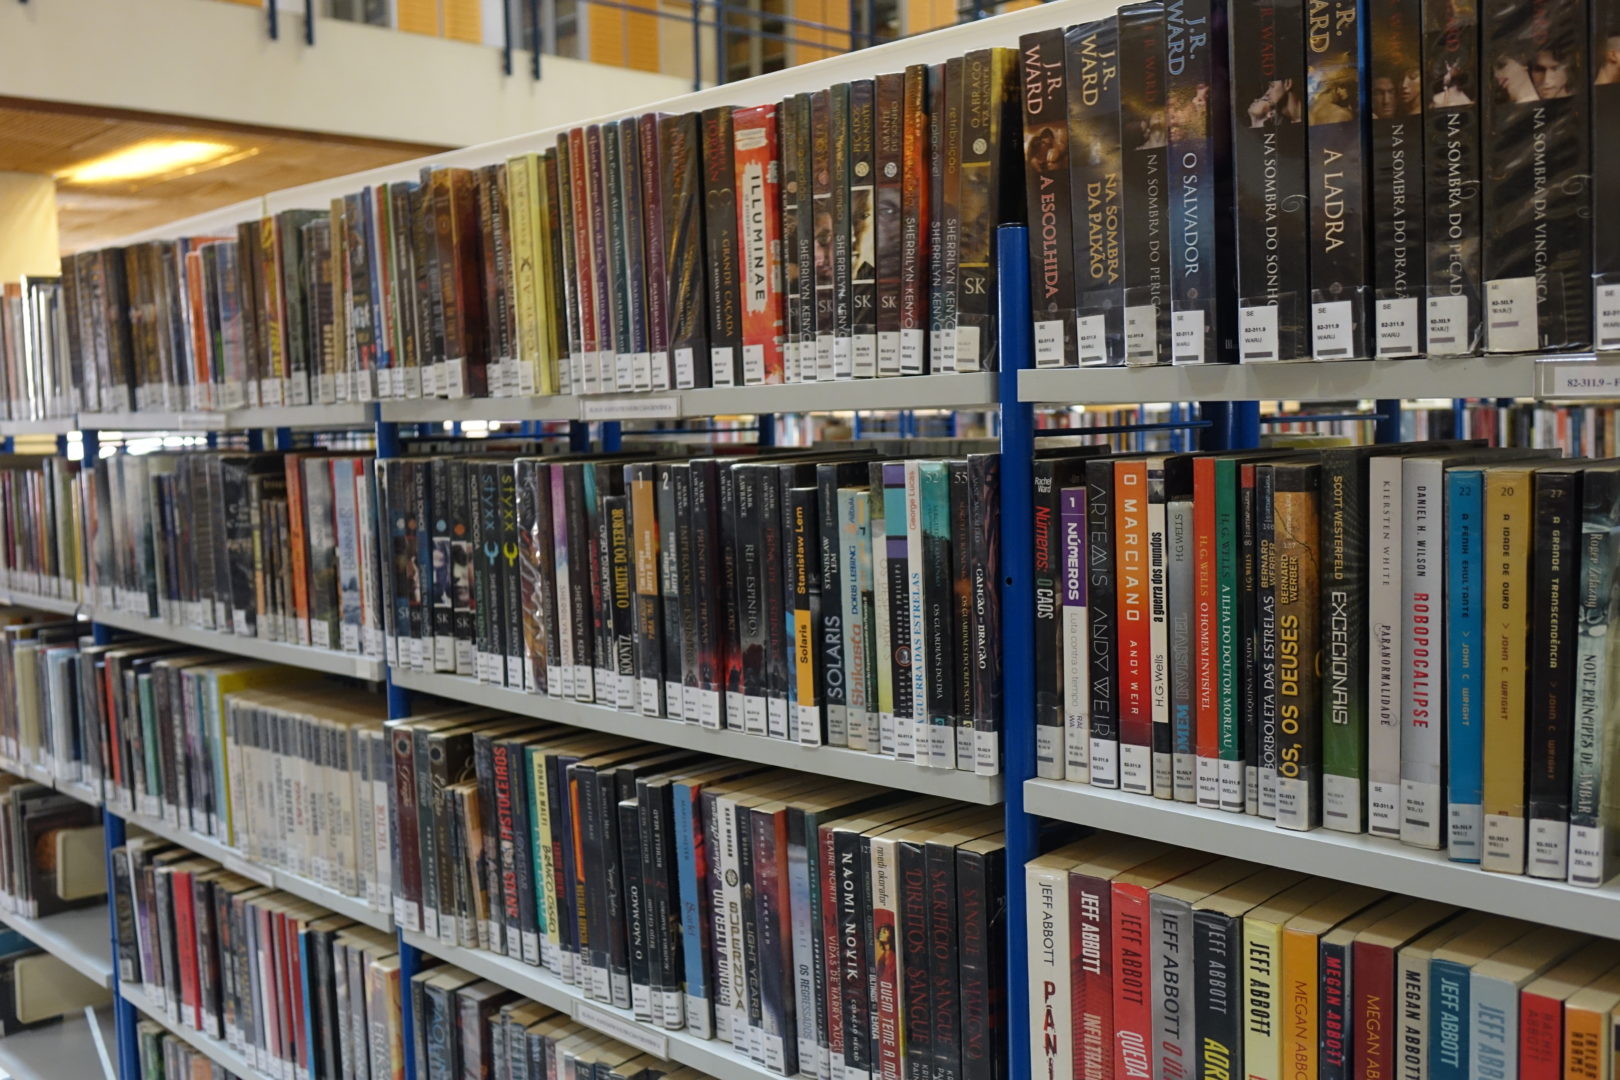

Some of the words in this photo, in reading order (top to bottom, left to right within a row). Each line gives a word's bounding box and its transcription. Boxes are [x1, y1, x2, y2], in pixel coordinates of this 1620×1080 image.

[1166, 0, 1185, 75] WARD
[1189, 16, 1206, 60] J.R.
[1024, 44, 1043, 115] WARD
[1043, 61, 1062, 100] J.R.
[1080, 33, 1099, 106] WARD
[1100, 50, 1116, 91] J.R.
[1181, 152, 1198, 170] O
[1264, 133, 1276, 156] NA
[1324, 148, 1342, 165] A
[1040, 175, 1054, 190] A
[1087, 183, 1099, 206] DA
[1105, 173, 1117, 201] NA
[1264, 158, 1278, 222] SOMBRA
[1183, 175, 1199, 277] SALVADOR
[1324, 169, 1344, 253] LADRA
[751, 175, 766, 300] ILLUMINAE
[905, 217, 915, 282] SHERRILYN
[1041, 193, 1060, 299] ESCOLHIDA
[1088, 207, 1104, 279] PAIXÃO
[1106, 204, 1120, 284] SOMBRA
[1266, 226, 1278, 249] DO
[964, 277, 986, 295] SK
[904, 288, 914, 328] KENYO
[1567, 378, 1605, 388] 82-311.9
[662, 472, 669, 490] 2
[926, 472, 940, 483] 52
[953, 471, 968, 484] 55
[1035, 477, 1052, 485] Rachel
[1124, 474, 1137, 486] O
[1333, 475, 1343, 505] SCOTT
[1459, 486, 1472, 497] 22
[1500, 486, 1514, 497] 20
[501, 474, 515, 532] styxx
[794, 506, 804, 533] Lem
[1382, 480, 1391, 540] KIERSTEN
[1417, 486, 1427, 521] DANIEL
[1503, 513, 1511, 521] A
[1552, 516, 1561, 524] A
[611, 508, 625, 546] TERROR
[1035, 505, 1051, 573] Números:
[1090, 483, 1108, 587] ARTEMIS
[1333, 505, 1344, 580] WESTERFELD
[1417, 525, 1426, 536] H.
[1502, 526, 1511, 557] IDADE
[613, 548, 627, 564] DO
[745, 544, 754, 562] REI
[796, 536, 806, 595] Stanislaw
[1067, 522, 1081, 601] NÚMEROS
[1124, 499, 1140, 621] MARCIANO
[1151, 532, 1162, 567] mundos
[1382, 546, 1391, 587] WHITE
[1416, 540, 1426, 578] WILSON
[1502, 563, 1511, 576] DE
[1552, 529, 1561, 572] GRANDE
[615, 566, 629, 599] LIMITE
[1037, 578, 1053, 589] O
[1151, 568, 1163, 585] dos
[1200, 560, 1209, 597] WELLS
[1221, 584, 1231, 593] A
[1281, 554, 1289, 604] BERNARD
[1289, 556, 1299, 602] WERBER
[1502, 582, 1511, 610] OURO
[746, 576, 758, 637] ESPINHOS
[911, 573, 922, 636] ESTRELAS
[1037, 589, 1054, 620] CAOS
[1152, 586, 1165, 616] guerra
[1200, 602, 1209, 612] O
[1222, 594, 1231, 623] ILHA
[799, 624, 809, 664] Solaris
[1093, 606, 1109, 672] ANDY
[1201, 613, 1210, 656] HOMEM
[1222, 624, 1232, 644] DO
[1263, 595, 1275, 659] ESTRELAS
[618, 634, 634, 676] KOONTZ
[824, 615, 843, 698] SOLARIS
[914, 638, 923, 662] DAS
[1130, 640, 1139, 675] ANDY
[1223, 645, 1232, 695] DOUTOR
[1280, 614, 1299, 696] DEUSES
[1331, 591, 1348, 725] EXCECIONAIS
[1413, 592, 1430, 729] ROBOPOCALIPSE
[1583, 654, 1597, 685] NOVE
[1154, 654, 1164, 707] H.G.Wells
[1202, 658, 1211, 711] INVISÍVEL
[1264, 660, 1275, 690] DAS
[1381, 624, 1391, 726] PARANORMALIDADE
[1093, 677, 1110, 736] WEIR
[1130, 682, 1139, 716] WEIR
[1580, 688, 1597, 749] PRÍNCIPES
[1223, 697, 1233, 748] MOREAU
[1281, 705, 1299, 735] OS
[1279, 743, 1302, 778] ÓS,
[1579, 752, 1593, 768] DE
[537, 763, 545, 801] RONALD
[841, 853, 855, 910] NAOMI
[1039, 882, 1053, 909] JEFF
[1081, 891, 1099, 922] JEFF
[746, 922, 757, 964] LIGHT
[1042, 911, 1055, 967] ABBOTT
[1081, 922, 1101, 974] ABBOTT
[1121, 912, 1142, 945] JEFF
[1160, 911, 1179, 953] JEFF
[1207, 924, 1226, 957] JEFF
[636, 951, 643, 960] O
[728, 902, 746, 1011] SUPERNOVA
[799, 964, 809, 975] OS
[844, 922, 859, 980] NOVIK
[1250, 941, 1270, 976] JEFF
[748, 967, 760, 1018] YEARS
[880, 980, 893, 1012] QUEM
[1121, 948, 1144, 1006] ABBOTT
[1208, 960, 1227, 1014] ABBOTT
[1326, 956, 1342, 1007] MEGAN
[1405, 969, 1421, 1021] MEGAN
[1441, 977, 1460, 1011] JEFF
[800, 978, 813, 1039] REGRESSADOS
[1163, 955, 1180, 1040] ABBOTT
[1250, 978, 1271, 1037] ABBOTT
[1295, 980, 1308, 1039] MEGAN
[881, 1017, 895, 1050] TEME
[1326, 1009, 1342, 1067] ABBOTT
[1366, 994, 1381, 1056] MEGAN
[1440, 1011, 1460, 1068] ABBOTT
[1116, 1030, 1150, 1080] QUEDA
